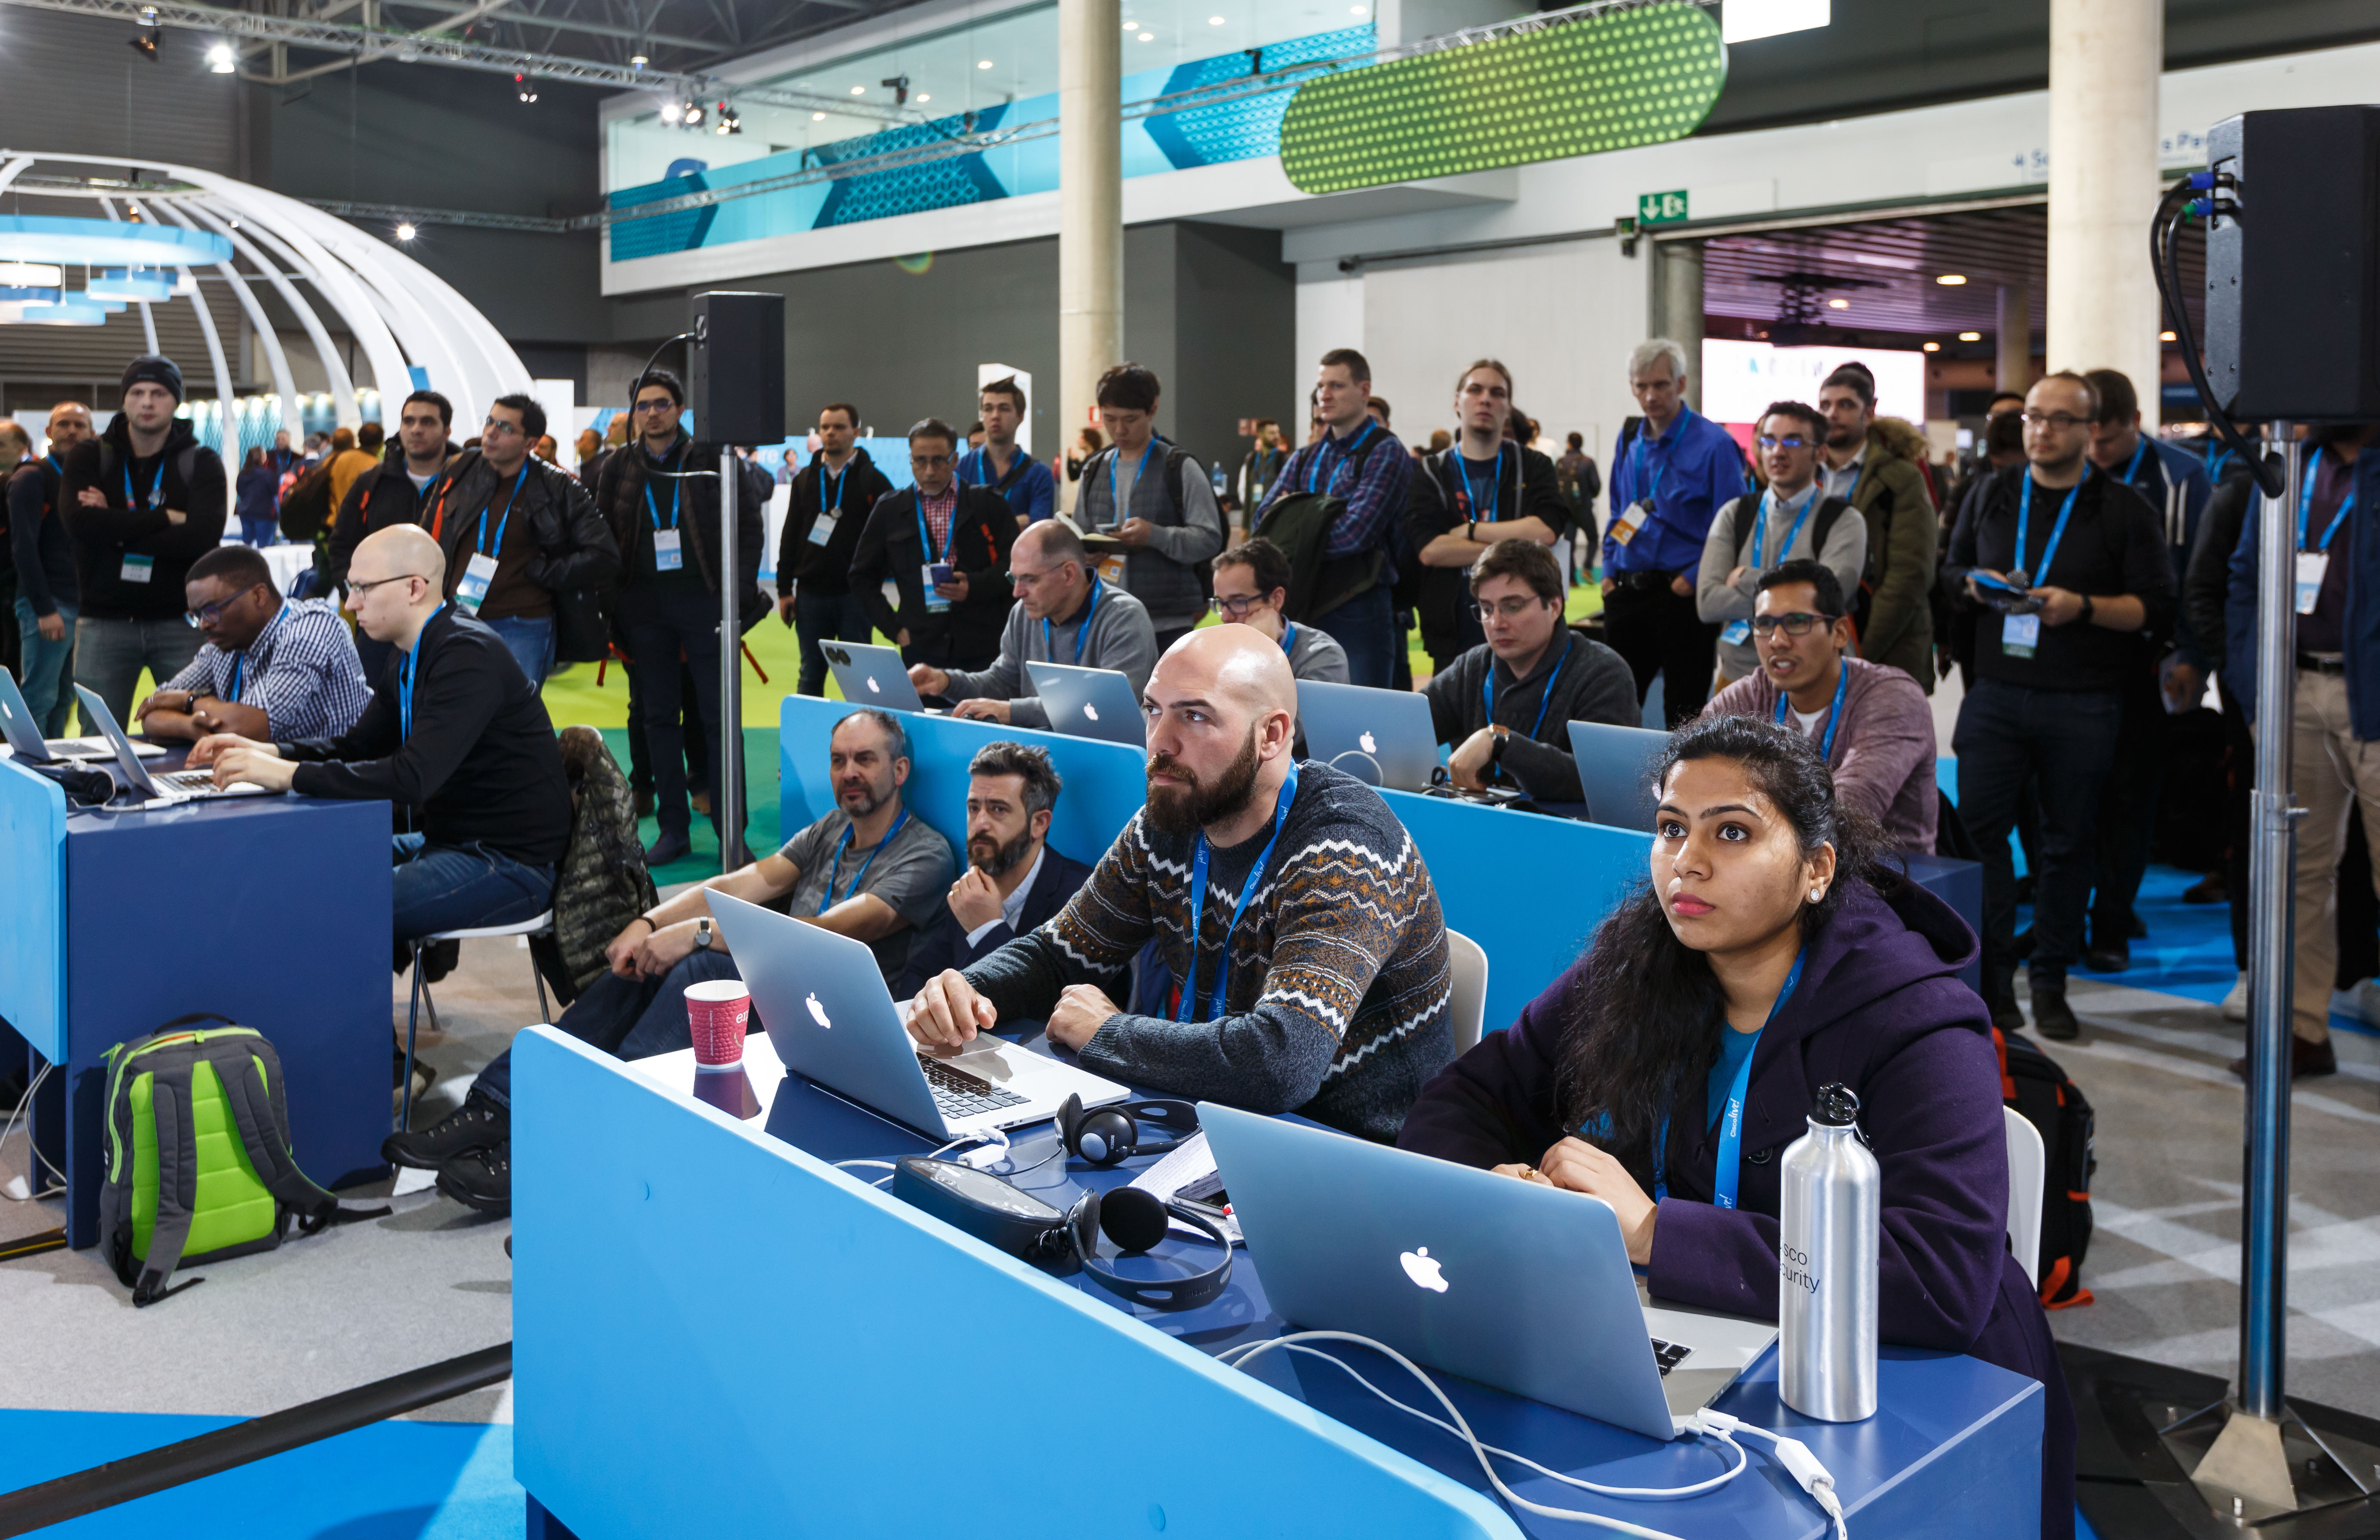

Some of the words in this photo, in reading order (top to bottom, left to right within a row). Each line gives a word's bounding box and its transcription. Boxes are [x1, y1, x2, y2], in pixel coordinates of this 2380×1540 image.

[1280, 805, 1289, 820] live!
[1249, 861, 1265, 889] Ciscolive!
[1178, 1000, 1188, 1023] Ciscoliv
[1728, 1097, 1740, 1138] Ciscolive!
[1780, 1263, 1820, 1293] curity
